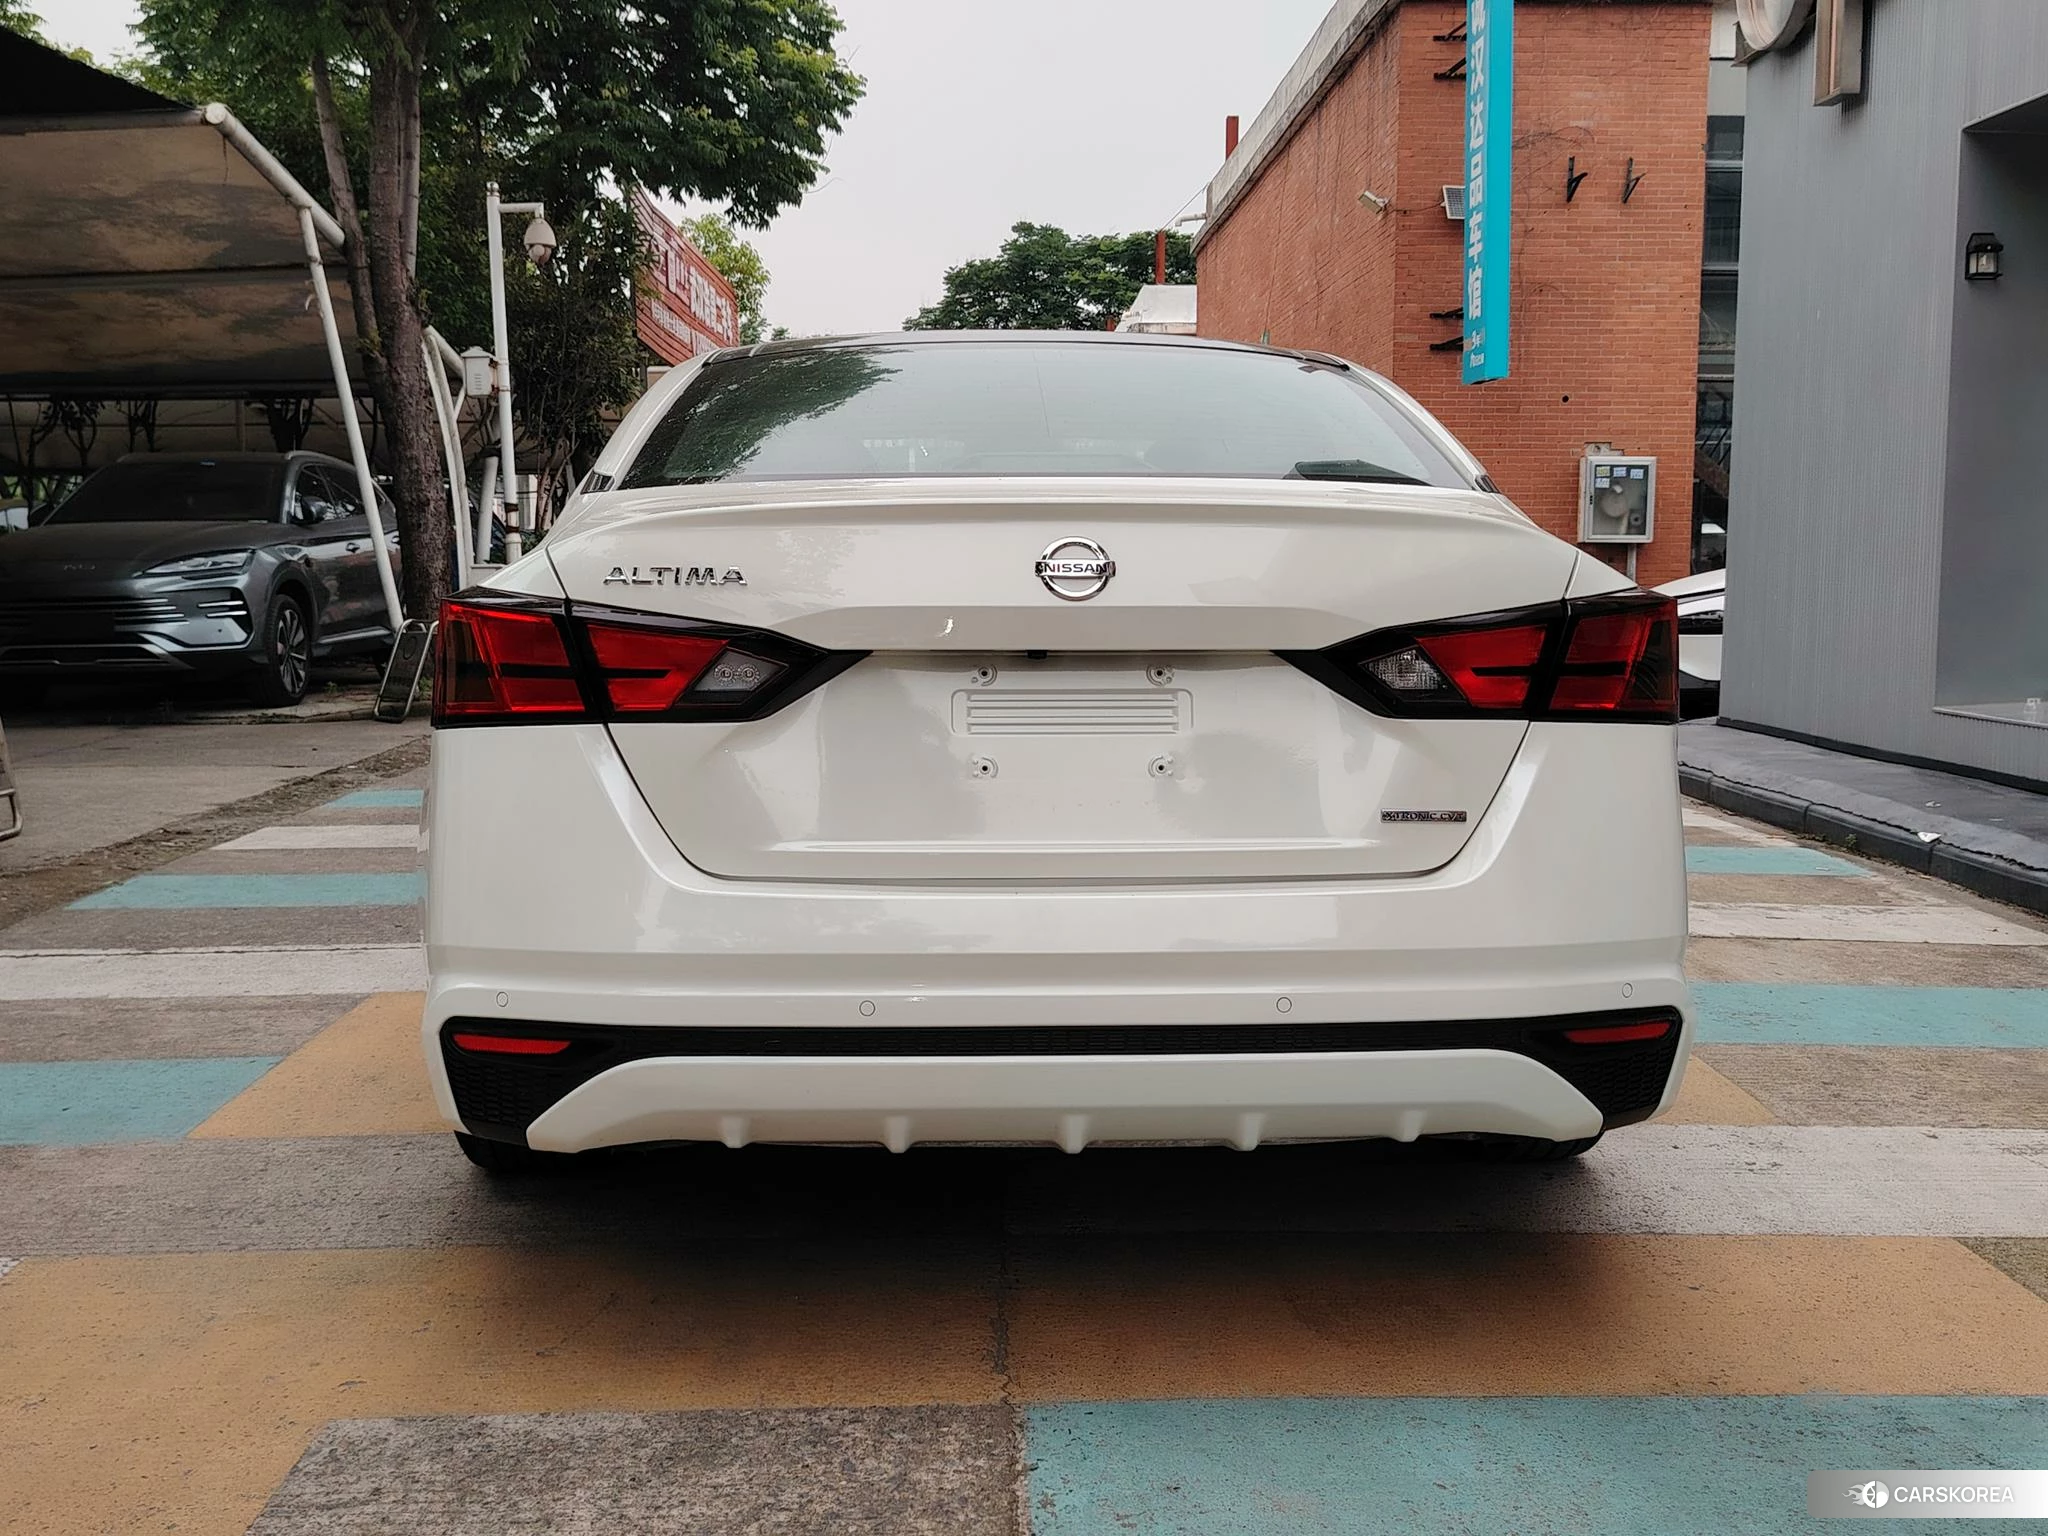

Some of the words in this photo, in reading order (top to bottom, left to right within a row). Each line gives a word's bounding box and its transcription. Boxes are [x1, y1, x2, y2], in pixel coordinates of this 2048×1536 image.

[1044, 563, 1108, 573] NISSAN
[603, 566, 748, 585] ALTIMA
[1382, 810, 1437, 821] XTRONIC
[1440, 811, 1465, 821] CVT
